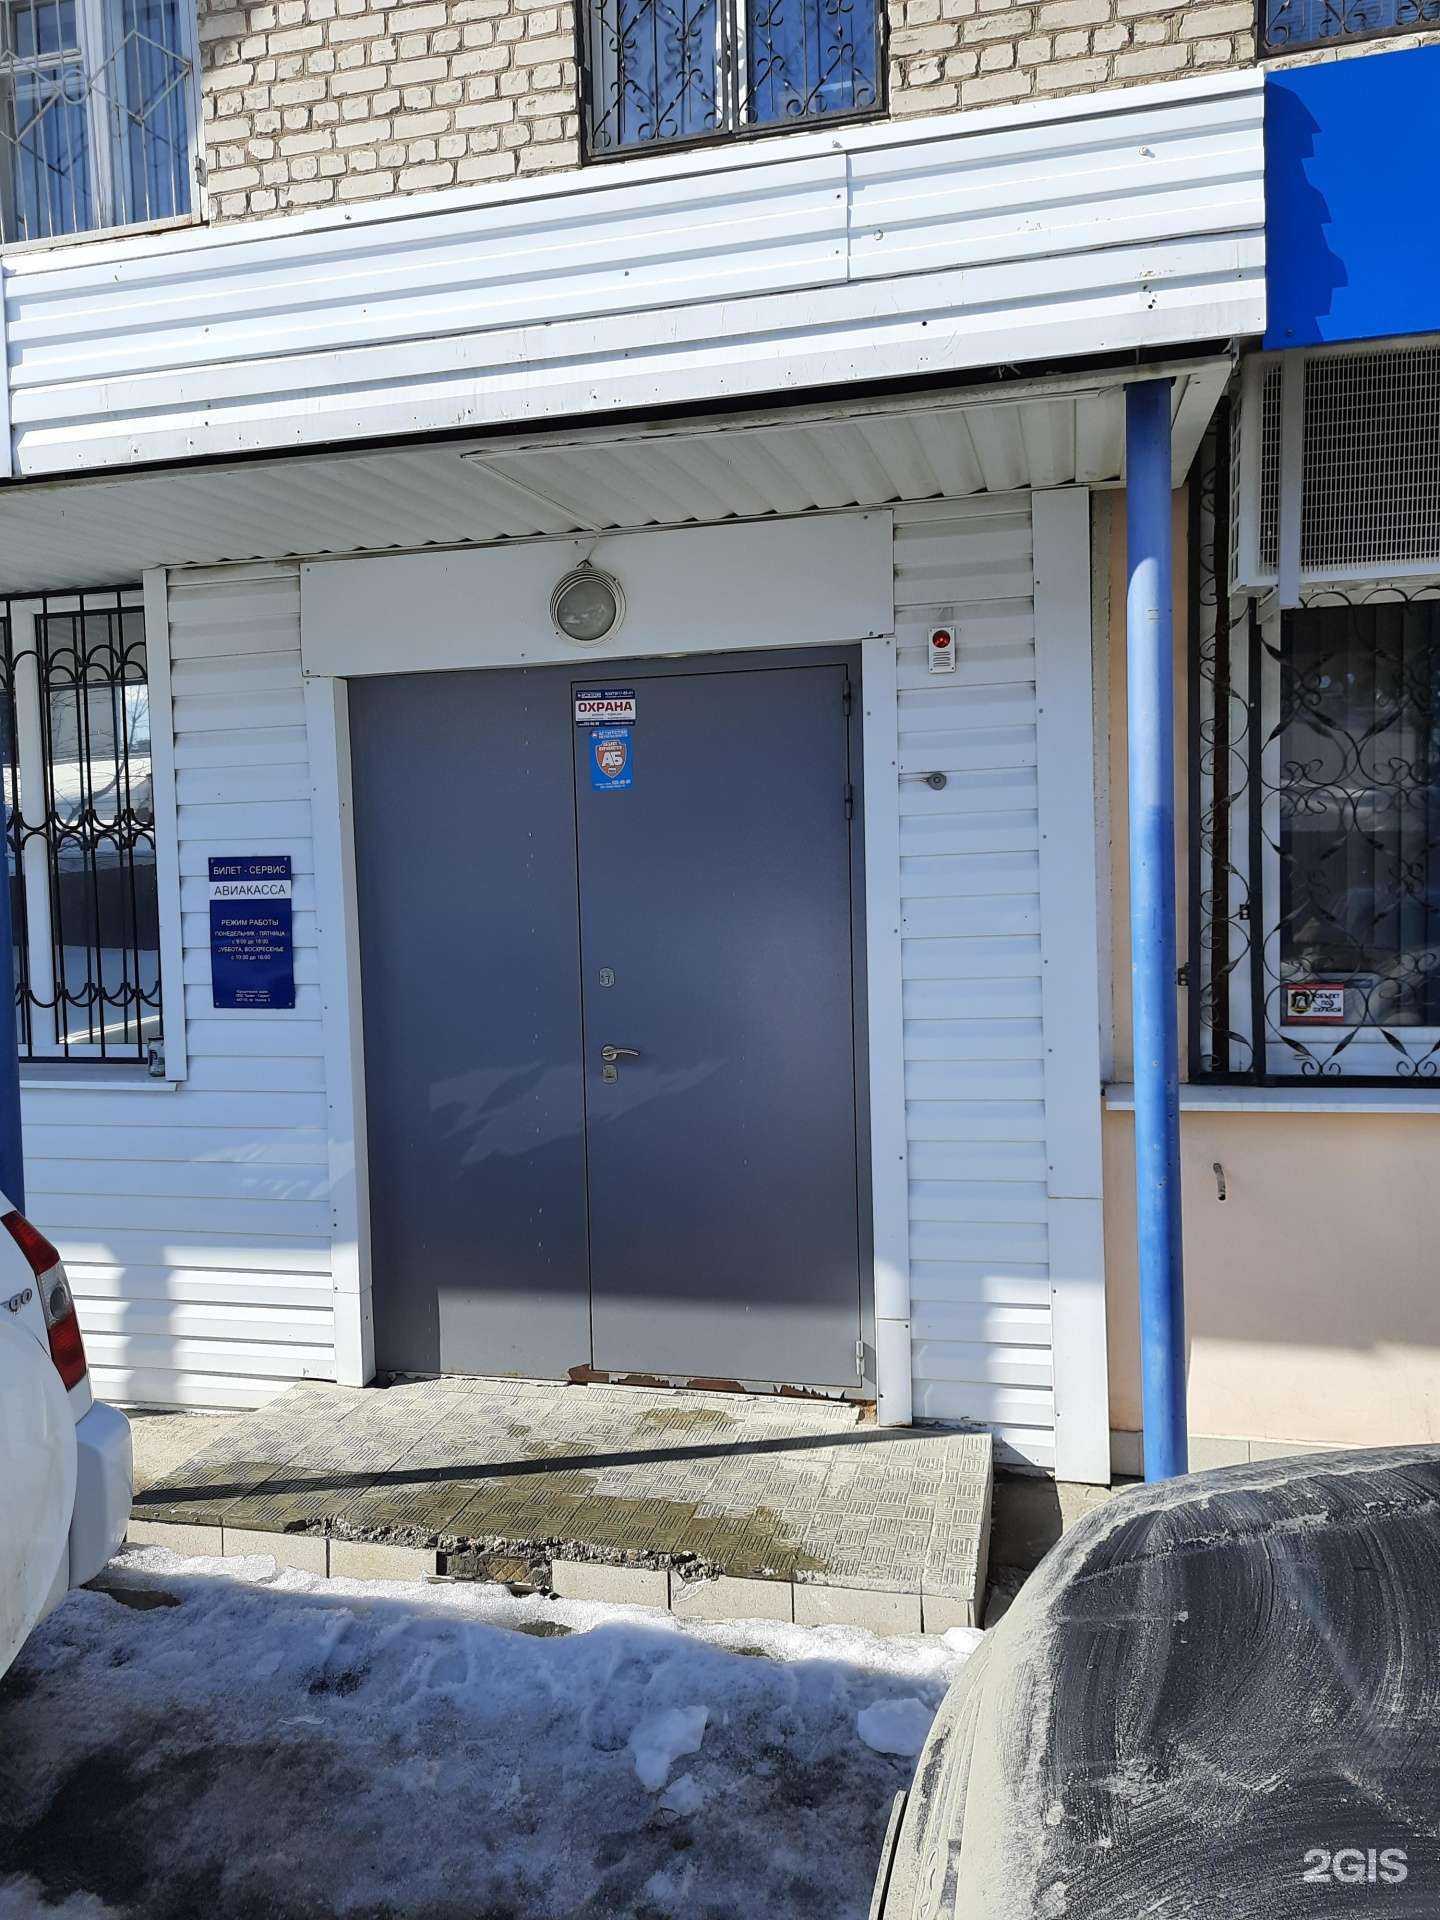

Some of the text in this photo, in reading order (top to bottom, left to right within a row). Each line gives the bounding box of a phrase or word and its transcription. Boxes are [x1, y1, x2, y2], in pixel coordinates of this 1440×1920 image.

[578, 702, 632, 712] ОХРАНА
[602, 751, 623, 767] АБ
[213, 866, 242, 875] БИЛЕТ
[249, 865, 286, 874] СЕРВИС
[214, 884, 286, 896] АВИАКАССА
